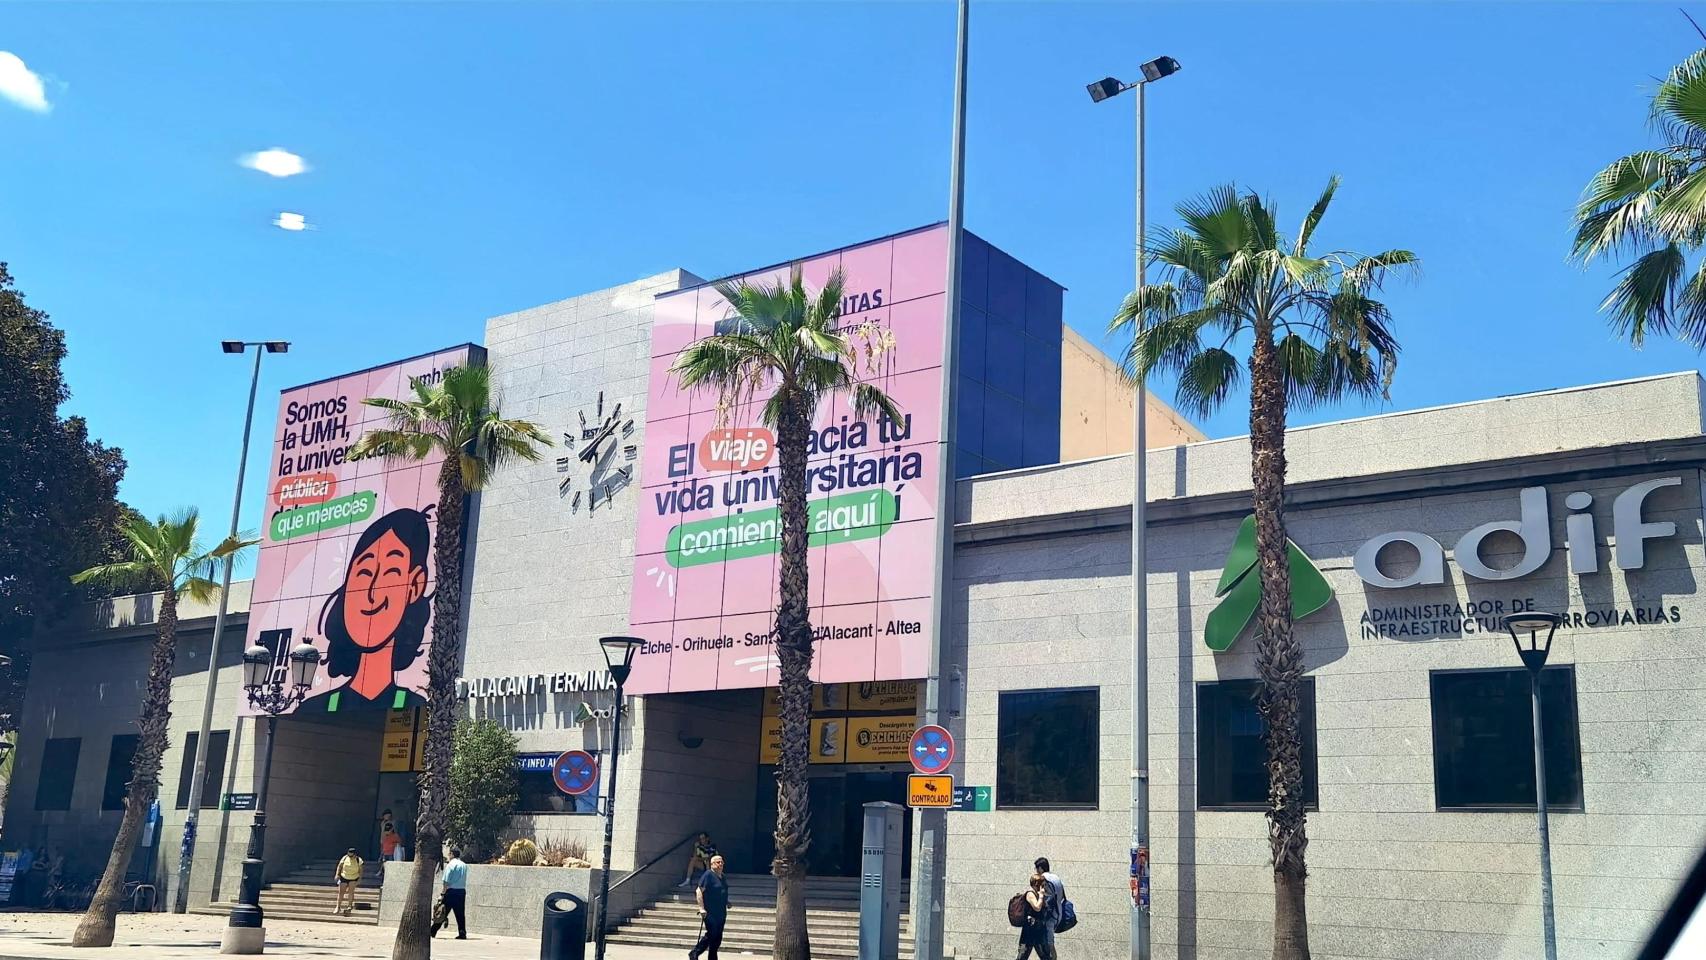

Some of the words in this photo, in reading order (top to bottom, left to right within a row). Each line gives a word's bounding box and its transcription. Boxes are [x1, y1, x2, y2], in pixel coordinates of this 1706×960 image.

[285, 396, 347, 425] Somos
[282, 428, 296, 450] la
[301, 415, 350, 446] UMH,
[668, 443, 695, 478] El
[710, 432, 768, 467] viaje
[806, 416, 867, 455] acia
[877, 412, 911, 443] tu
[278, 453, 292, 477] la
[280, 478, 329, 503] pública
[655, 478, 714, 516] vida
[723, 446, 922, 506] univrsitaria
[277, 515, 304, 536] que
[306, 498, 368, 527] mereces
[815, 493, 880, 537] aquí
[1353, 477, 1682, 588] adif
[1360, 600, 1504, 624] ADMINISTRADOR
[1512, 598, 1535, 613] DE
[640, 641, 672, 655] Elche
[682, 635, 733, 651] Orihuela
[885, 620, 921, 636] Altea
[1361, 616, 1509, 641] INFRAESTRUCTUR
[467, 674, 539, 698] ALACANT
[545, 671, 618, 694] TERMINA
[527, 758, 546, 768] INFO
[912, 795, 949, 803] CONTROLADO
